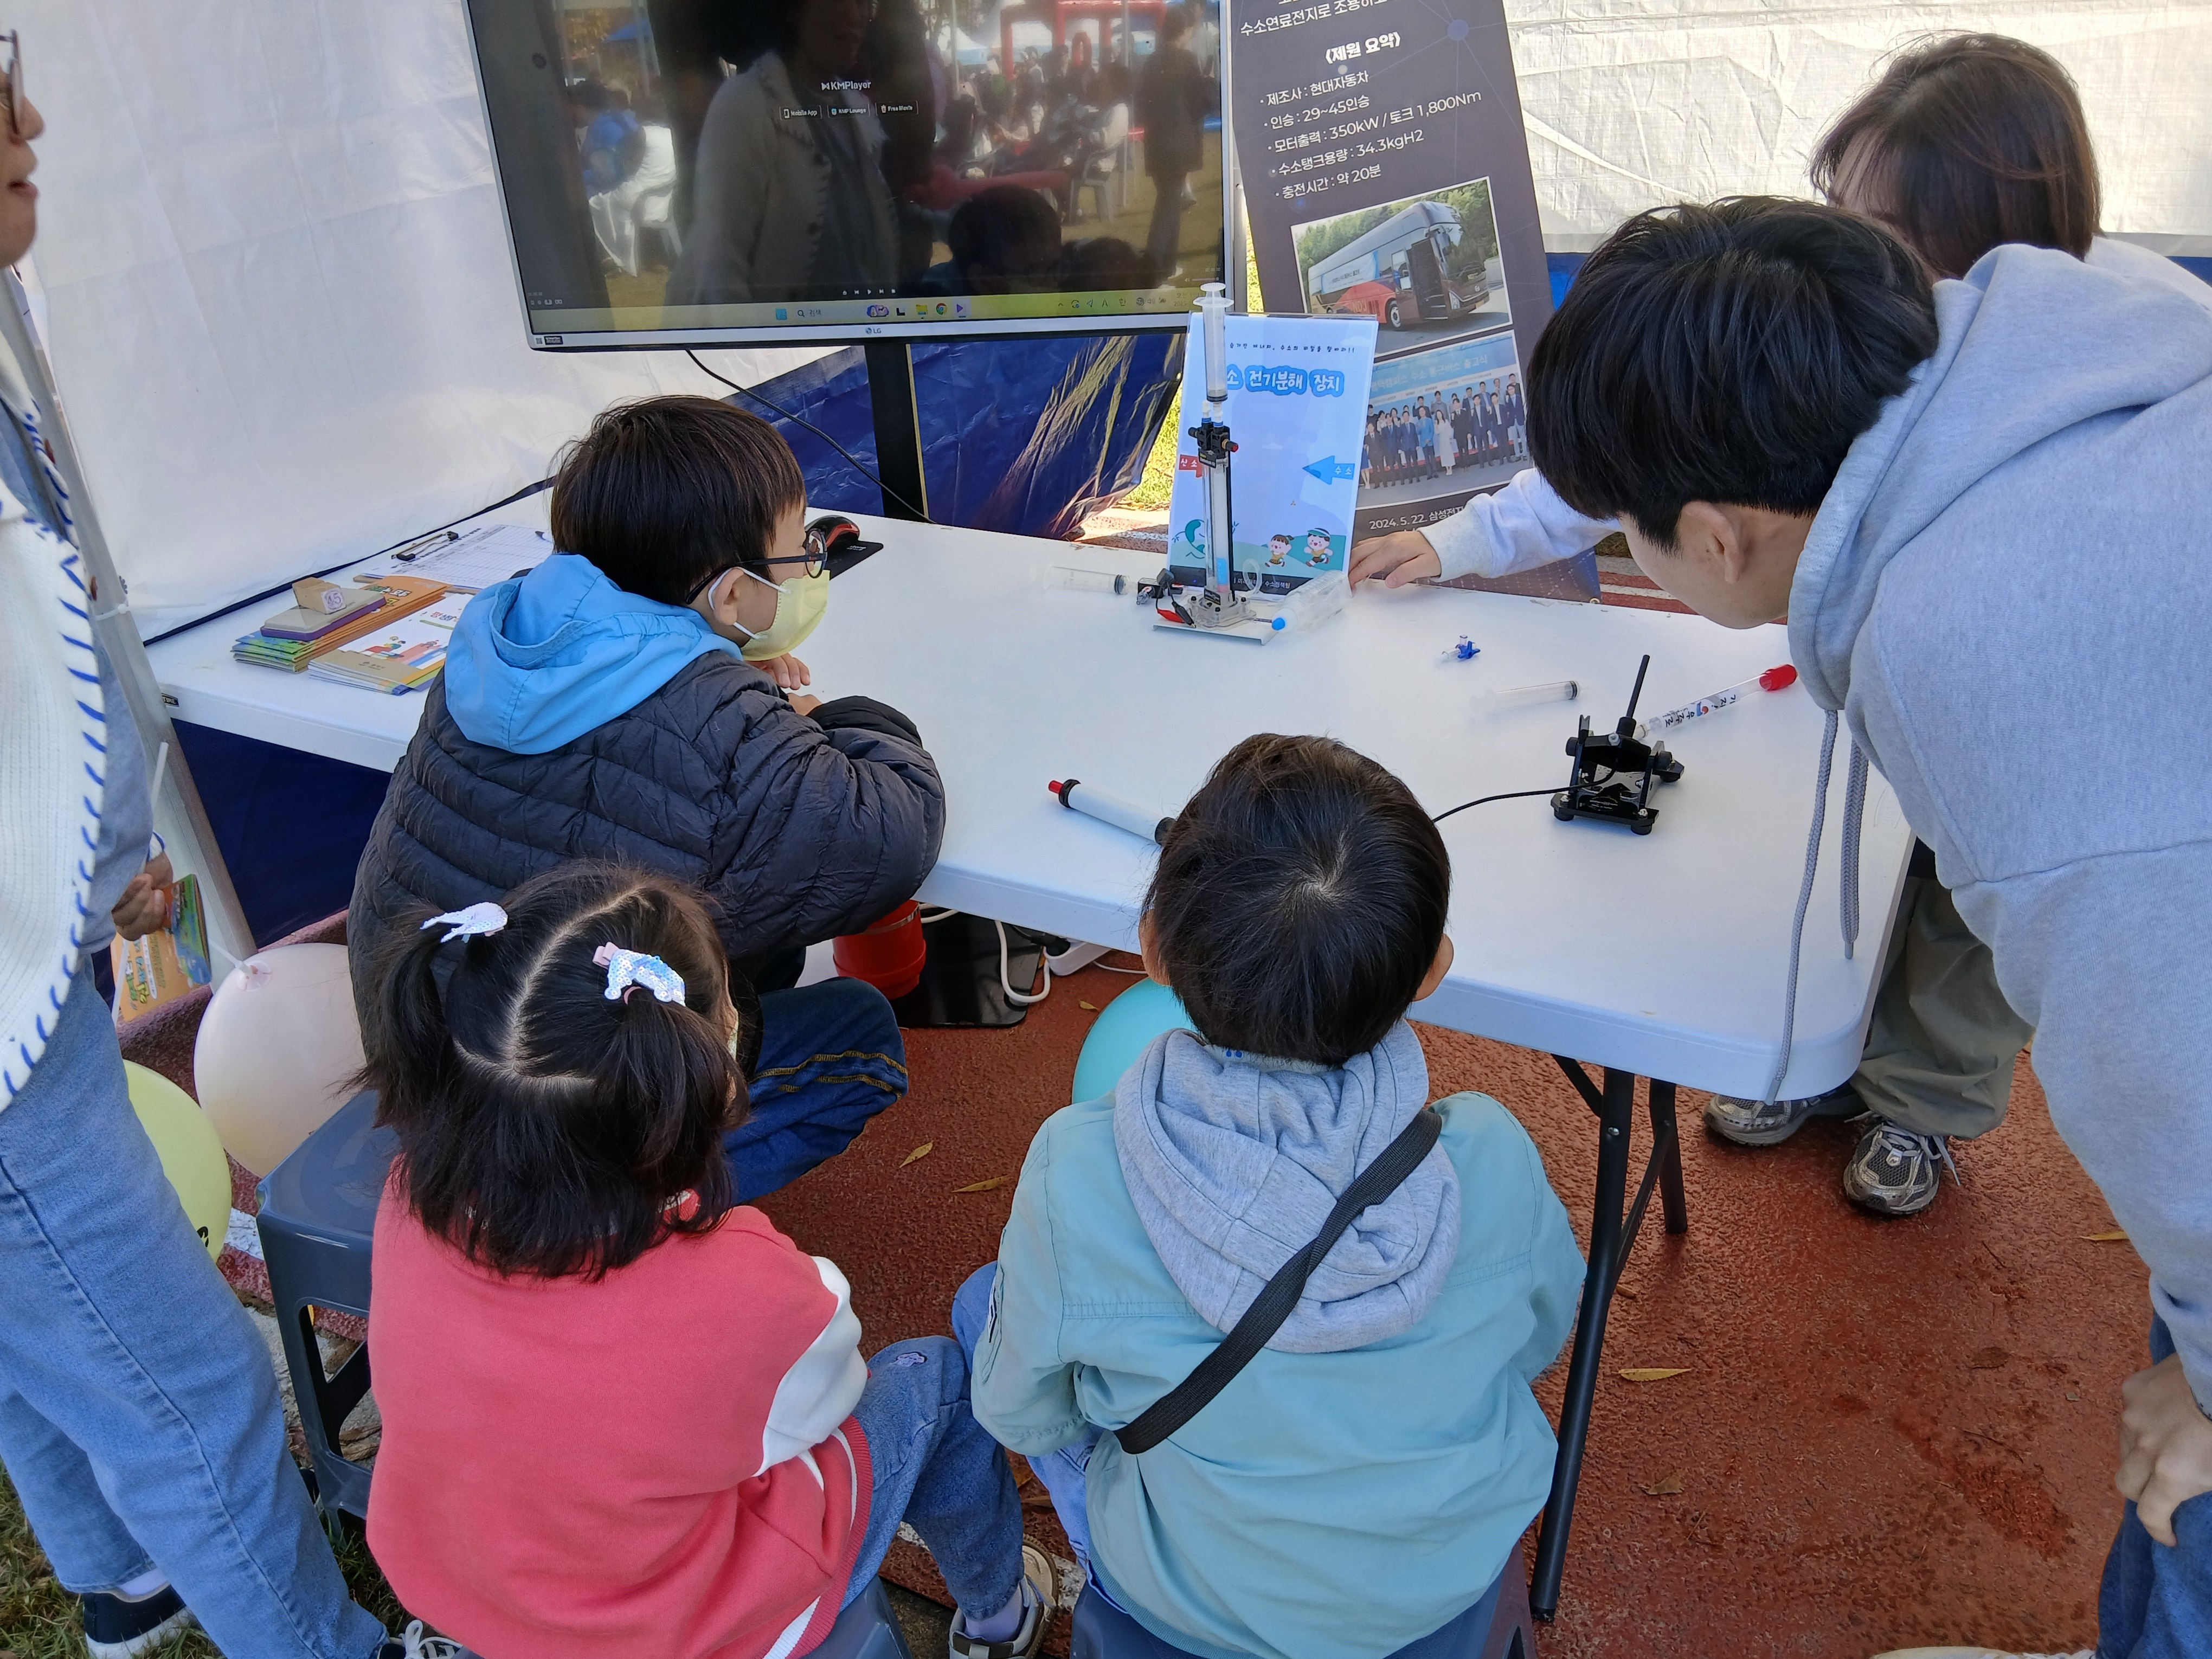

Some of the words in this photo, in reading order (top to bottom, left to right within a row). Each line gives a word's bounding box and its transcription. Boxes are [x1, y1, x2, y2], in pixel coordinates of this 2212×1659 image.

[1240, 3, 1332, 36] 수소연료전지로
[1334, 0, 1387, 14] 조용
[831, 81, 871, 91] KMPlayer
[1266, 87, 1302, 106] 제조사
[1309, 70, 1369, 96] 현대자동차
[1270, 113, 1294, 130] 인승
[1302, 94, 1369, 122] 29~45인승
[1275, 131, 1321, 152] 모터출력
[1329, 115, 1379, 139] 350kW
[1390, 107, 1414, 124] 토크
[1417, 92, 1482, 117] 1,800Nm
[1278, 149, 1348, 175] 수소탱크용량
[1356, 129, 1425, 157] 34.3kgH2
[1282, 177, 1328, 199] 충전시간
[1337, 172, 1349, 184] 약
[1351, 164, 1381, 182] 20분
[1227, 369, 1239, 385] 소
[1249, 370, 1303, 391] 전기분해
[1313, 374, 1340, 392] 장치
[1334, 465, 1352, 475] 수소
[1369, 518, 1399, 530] 2024.
[1400, 516, 1410, 526] 5.
[1411, 514, 1427, 524] 22.
